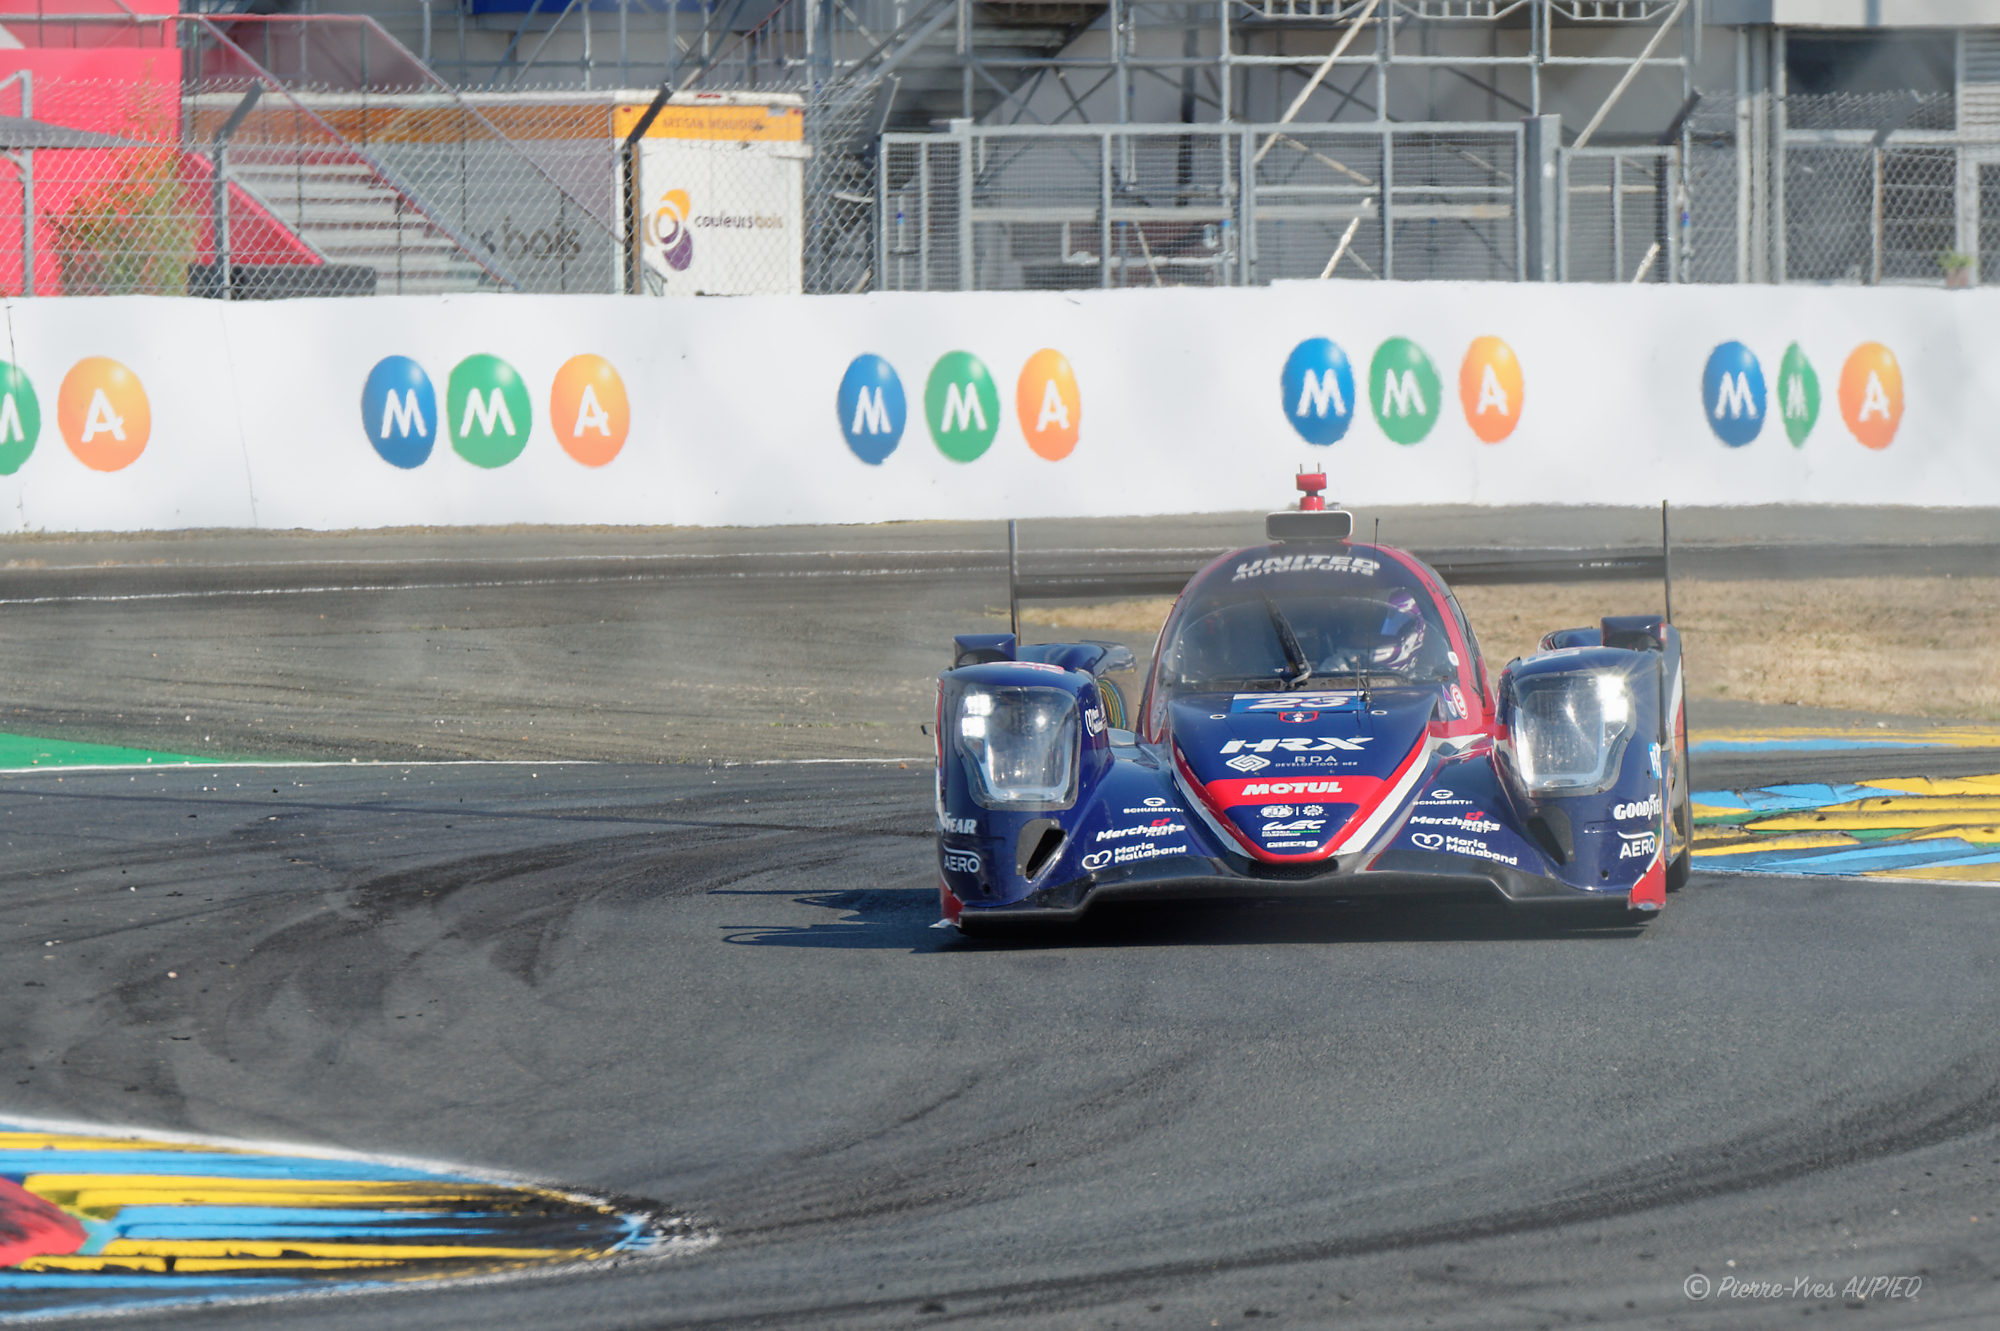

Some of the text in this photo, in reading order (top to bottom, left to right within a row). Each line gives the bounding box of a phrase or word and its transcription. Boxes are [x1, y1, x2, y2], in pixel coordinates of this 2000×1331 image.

[1236, 555, 1380, 573] UNITED
[1247, 696, 1350, 710] 23
[1220, 737, 1374, 754] HRX
[1294, 755, 1337, 763] RDA
[1241, 782, 1343, 795] MOTUL
[1262, 820, 1327, 831] WEC
[1410, 816, 1501, 832] Merchants
[1096, 823, 1186, 842] Merchants
[1114, 842, 1155, 855] Maria
[1446, 835, 1488, 849] Maria
[1619, 837, 1655, 859] AERO
[1114, 845, 1187, 863] Mallaband
[1446, 843, 1518, 866] Mallaband
[943, 855, 980, 873] AERO
